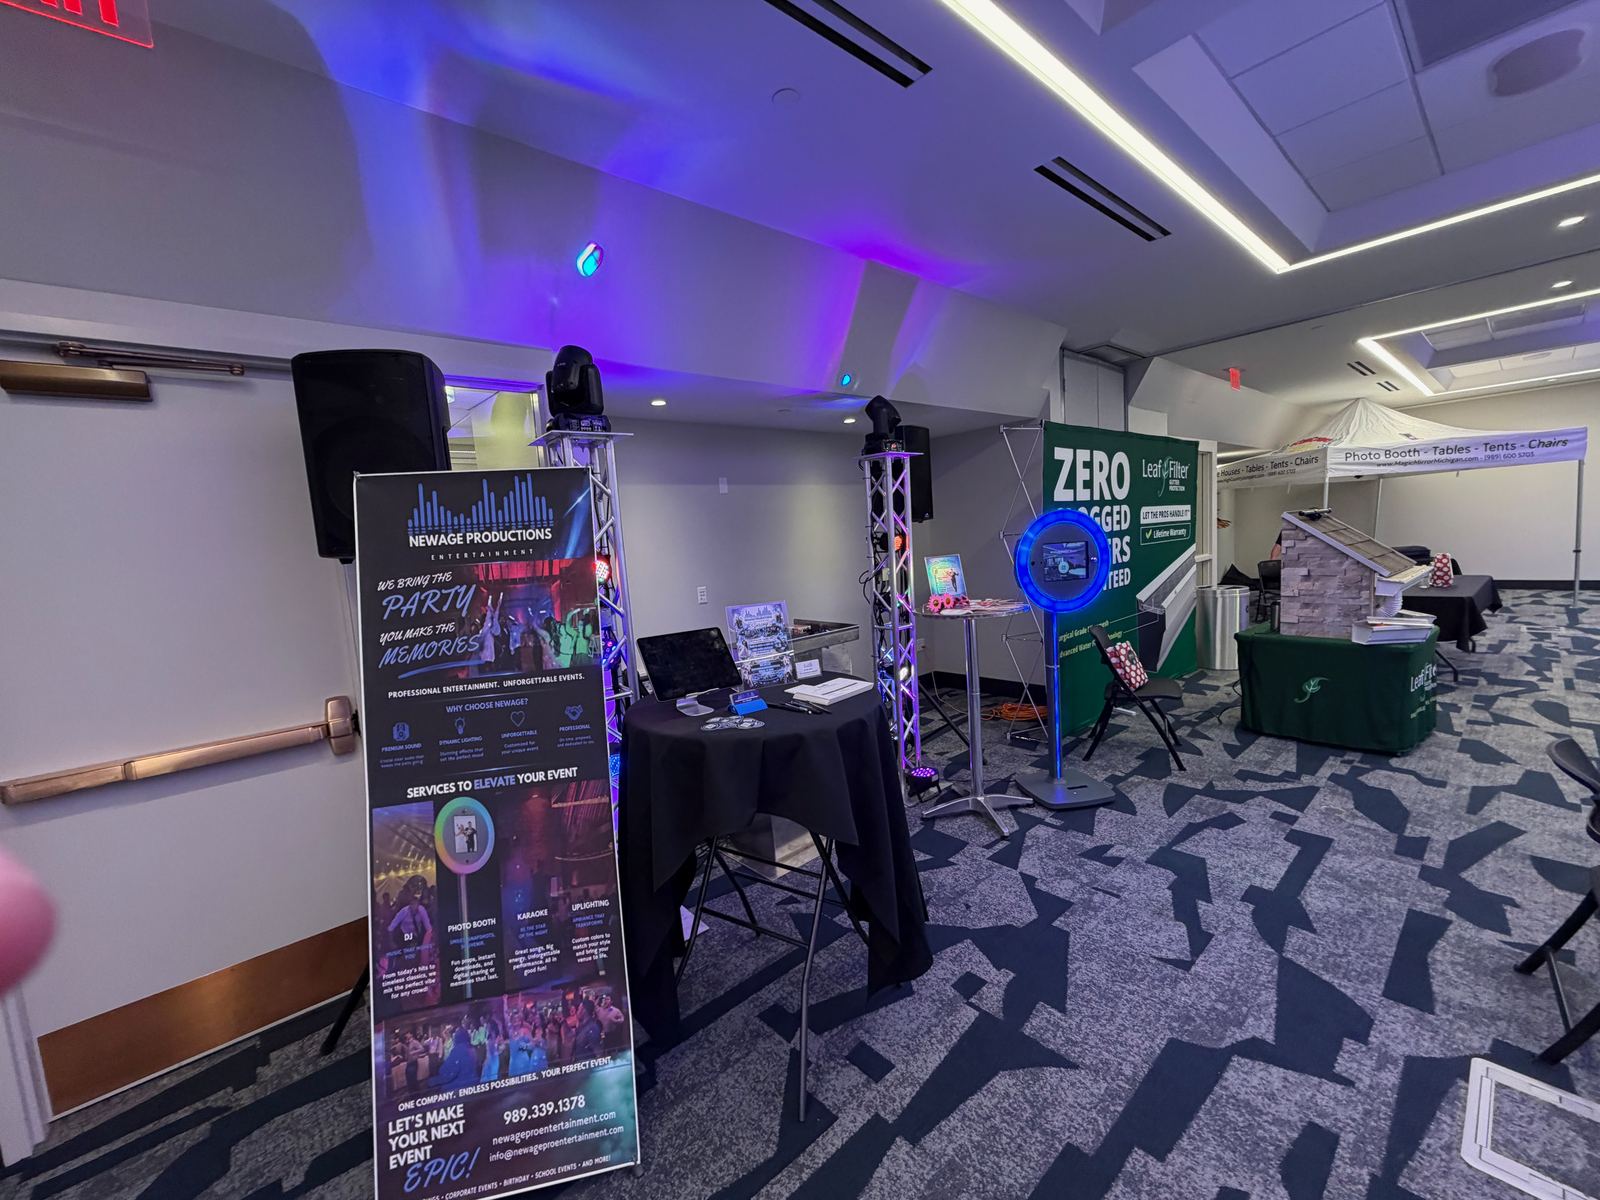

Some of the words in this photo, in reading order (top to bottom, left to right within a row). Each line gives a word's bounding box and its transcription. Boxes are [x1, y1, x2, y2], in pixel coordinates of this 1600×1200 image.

[1344, 451, 1381, 462] Photo
[1384, 448, 1420, 459] Booth
[1432, 444, 1471, 456] Tables
[1482, 441, 1517, 452] Tents
[1528, 438, 1569, 450] Chairs
[1054, 446, 1131, 502] ZERO
[1142, 458, 1163, 478] Leaf
[1168, 460, 1189, 479] Filter
[1220, 468, 1240, 477] Houses
[1246, 464, 1264, 473] Tables
[1270, 460, 1289, 470] Tents
[1294, 456, 1320, 466] Chairs
[1142, 512, 1150, 520] LET
[1150, 511, 1158, 519] THE
[1159, 510, 1169, 518] PROS
[1170, 510, 1184, 518] HANDLE
[409, 533, 464, 547] NEWAGE
[466, 528, 552, 544] PRODUCTIONS
[1153, 529, 1170, 538] Lifetime
[1170, 528, 1186, 537] Warranty
[431, 548, 534, 560] ENTERTAINMENT
[377, 580, 395, 591] WE
[397, 574, 430, 588] BRING
[432, 572, 452, 584] THE
[382, 584, 476, 620] PARTY
[380, 630, 404, 646] YOU
[403, 626, 434, 640] MAKE
[435, 622, 456, 634] THE
[378, 634, 481, 668] MEMORIES
[388, 687, 442, 698] PROFESSIONAL
[442, 681, 500, 694] ENTERTAINMENT.
[503, 676, 558, 688] UNFORGETTABLE
[558, 672, 585, 682] EVENTS.
[1410, 669, 1424, 692] Leaf
[446, 704, 464, 714] WHY
[464, 701, 494, 712] CHOOSE
[494, 698, 528, 709] NEWAGE?
[500, 730, 538, 738] UNFORGETTABLE
[559, 724, 590, 732] PROFESSIONAL
[382, 744, 404, 752] PREMIUM
[404, 742, 422, 750] SOUND
[406, 782, 456, 798] SERVICES
[457, 780, 472, 792] TO
[474, 774, 516, 790] ELEVATE
[516, 771, 546, 784] YOUR
[548, 767, 578, 780] EVENT
[517, 908, 548, 920] KARAOKE
[572, 900, 610, 911] UPLIGHTING
[448, 922, 472, 932] PHOTO
[472, 918, 496, 928] BOOTH
[404, 932, 413, 941] DJ
[572, 936, 590, 944] Custom
[478, 952, 496, 960] instant
[382, 972, 396, 980] From
[397, 968, 418, 976] today's
[524, 967, 536, 976] good
[382, 978, 405, 988] timeless
[404, 980, 424, 990] perfect
[398, 1100, 415, 1112] ONE
[416, 1090, 457, 1106] COMPANY.
[458, 1082, 490, 1098] ENDLESS
[490, 1072, 539, 1090] POSSIBILITIES.
[540, 1066, 562, 1079] YOUR
[562, 1061, 590, 1075] PERFECT
[503, 1094, 586, 1125] 989.339.1378
[388, 1114, 424, 1136] LET'S
[426, 1104, 464, 1126] MAKE
[492, 1110, 616, 1146] newageproentertainment.com
[388, 1129, 428, 1152] YOUR
[430, 1120, 466, 1141] NEXT
[489, 1124, 624, 1162] info@newageproentertainment.com
[389, 1145, 433, 1170] EVENT
[404, 1146, 480, 1193] EPIC!
[444, 1186, 477, 1200] CORPORATE
[478, 1181, 498, 1193] EVENTS
[503, 1174, 530, 1187] BIRTHDAY
[535, 1169, 557, 1180] SCHOOL
[558, 1162, 577, 1174] EVENTS
[582, 1158, 594, 1168] AND
